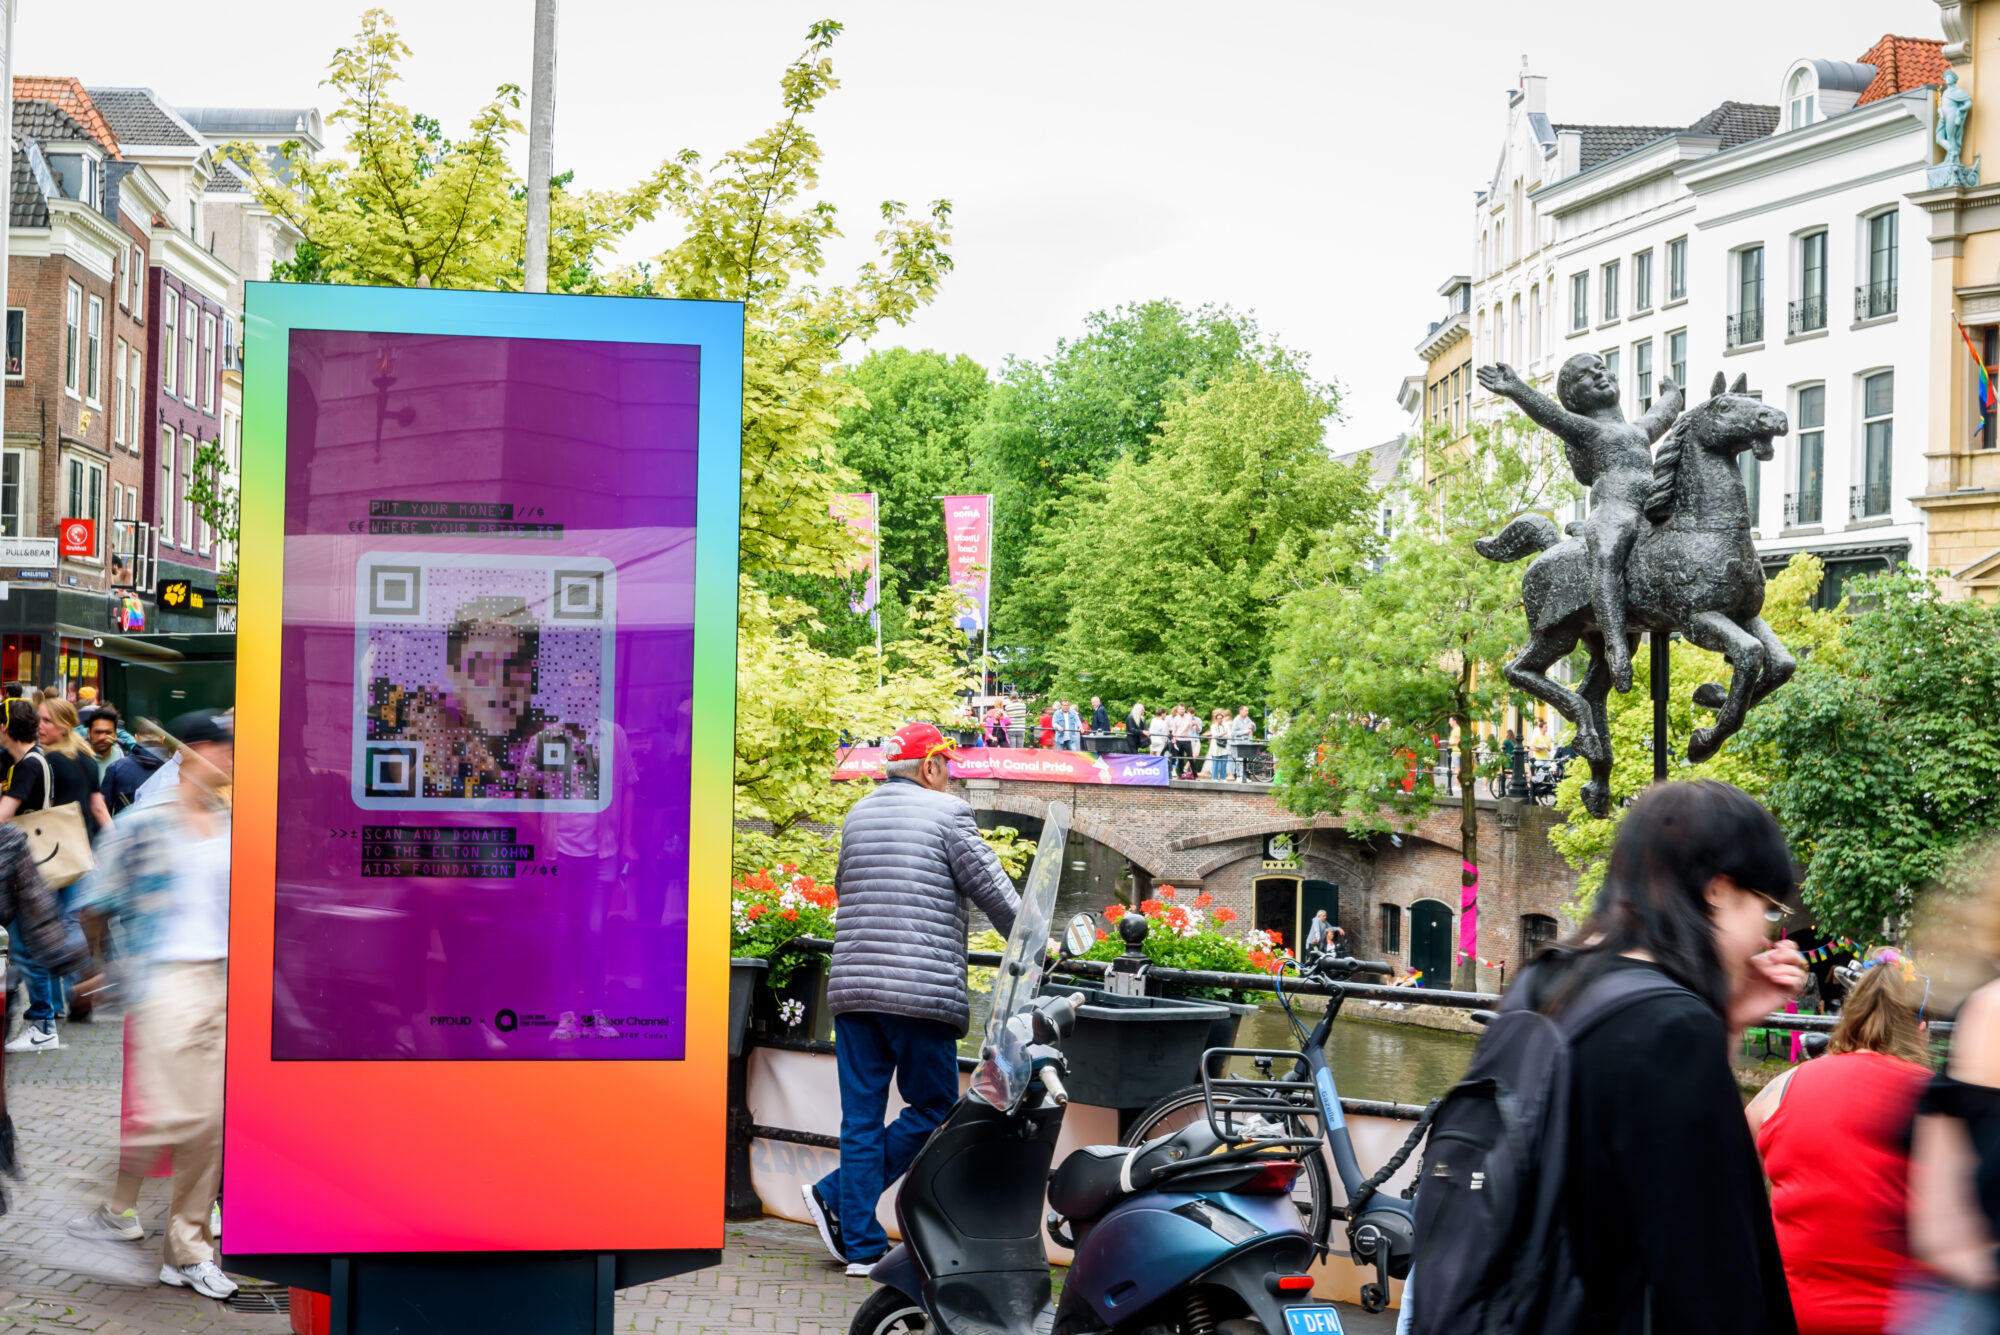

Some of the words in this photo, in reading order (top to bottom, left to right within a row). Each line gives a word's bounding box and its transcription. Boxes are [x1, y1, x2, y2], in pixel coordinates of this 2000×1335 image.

[371, 502, 399, 513] PUT
[411, 503, 448, 515] YOUR
[460, 505, 506, 517] MONEY
[371, 521, 419, 533] WHERE
[431, 523, 468, 535] YOUR
[480, 524, 526, 537] PRIDE
[537, 526, 555, 538] IS
[5, 548, 51, 557] PULL&BEAR
[957, 757, 1000, 769] Utrecht
[1003, 759, 1040, 771] Canal
[1042, 761, 1074, 773] Pride
[1123, 766, 1160, 777] Amac
[364, 828, 402, 840] SCAN
[414, 829, 440, 841] AND
[453, 829, 509, 842] DONATE
[364, 845, 382, 857] TO
[393, 845, 420, 857] THE
[432, 846, 480, 858] ELTON
[491, 847, 528, 859] JOHN
[363, 863, 401, 876] AIDS
[412, 863, 509, 877] FOUNDATION
[596, 1016, 625, 1026] Clear
[626, 1016, 669, 1027] Channel
[1303, 1312, 1339, 1333] DFN
